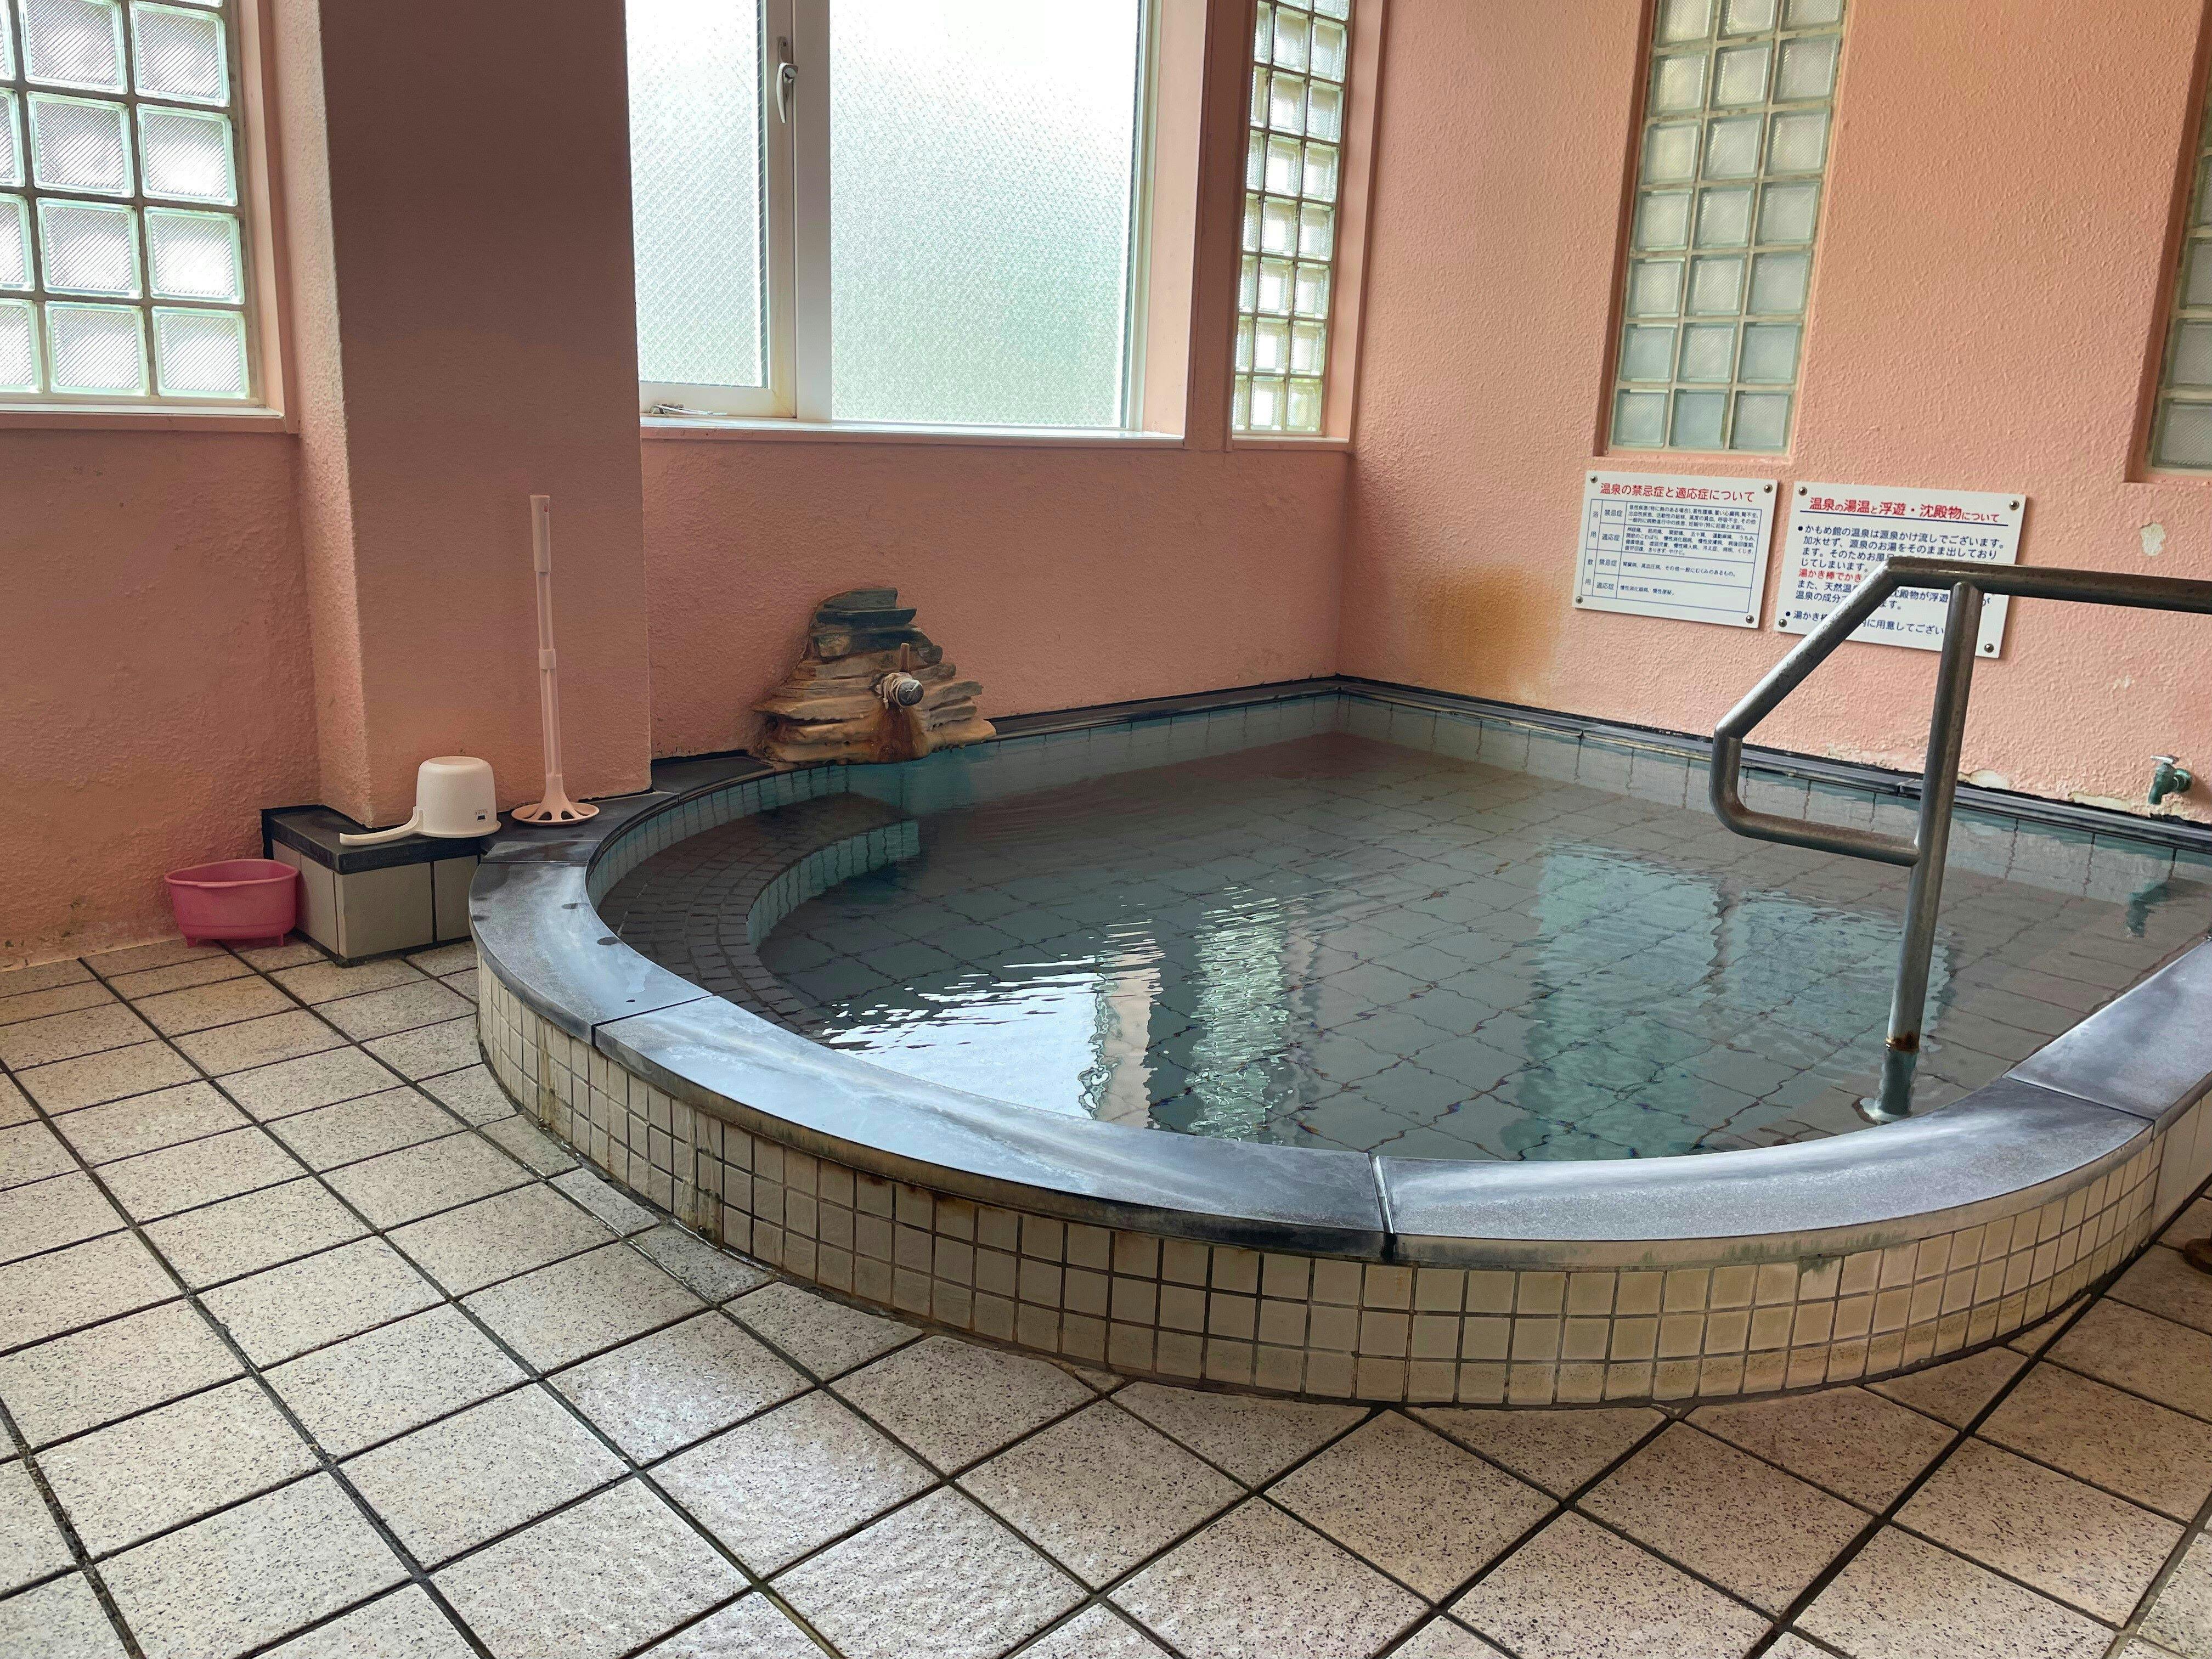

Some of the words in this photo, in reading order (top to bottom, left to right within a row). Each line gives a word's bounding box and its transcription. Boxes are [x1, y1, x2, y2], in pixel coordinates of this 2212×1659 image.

[1600, 483, 1755, 502] 温泉の禁忌症と適応症について
[1809, 497, 2000, 523] 温泉の湯温と浮遊・沈殿物について
